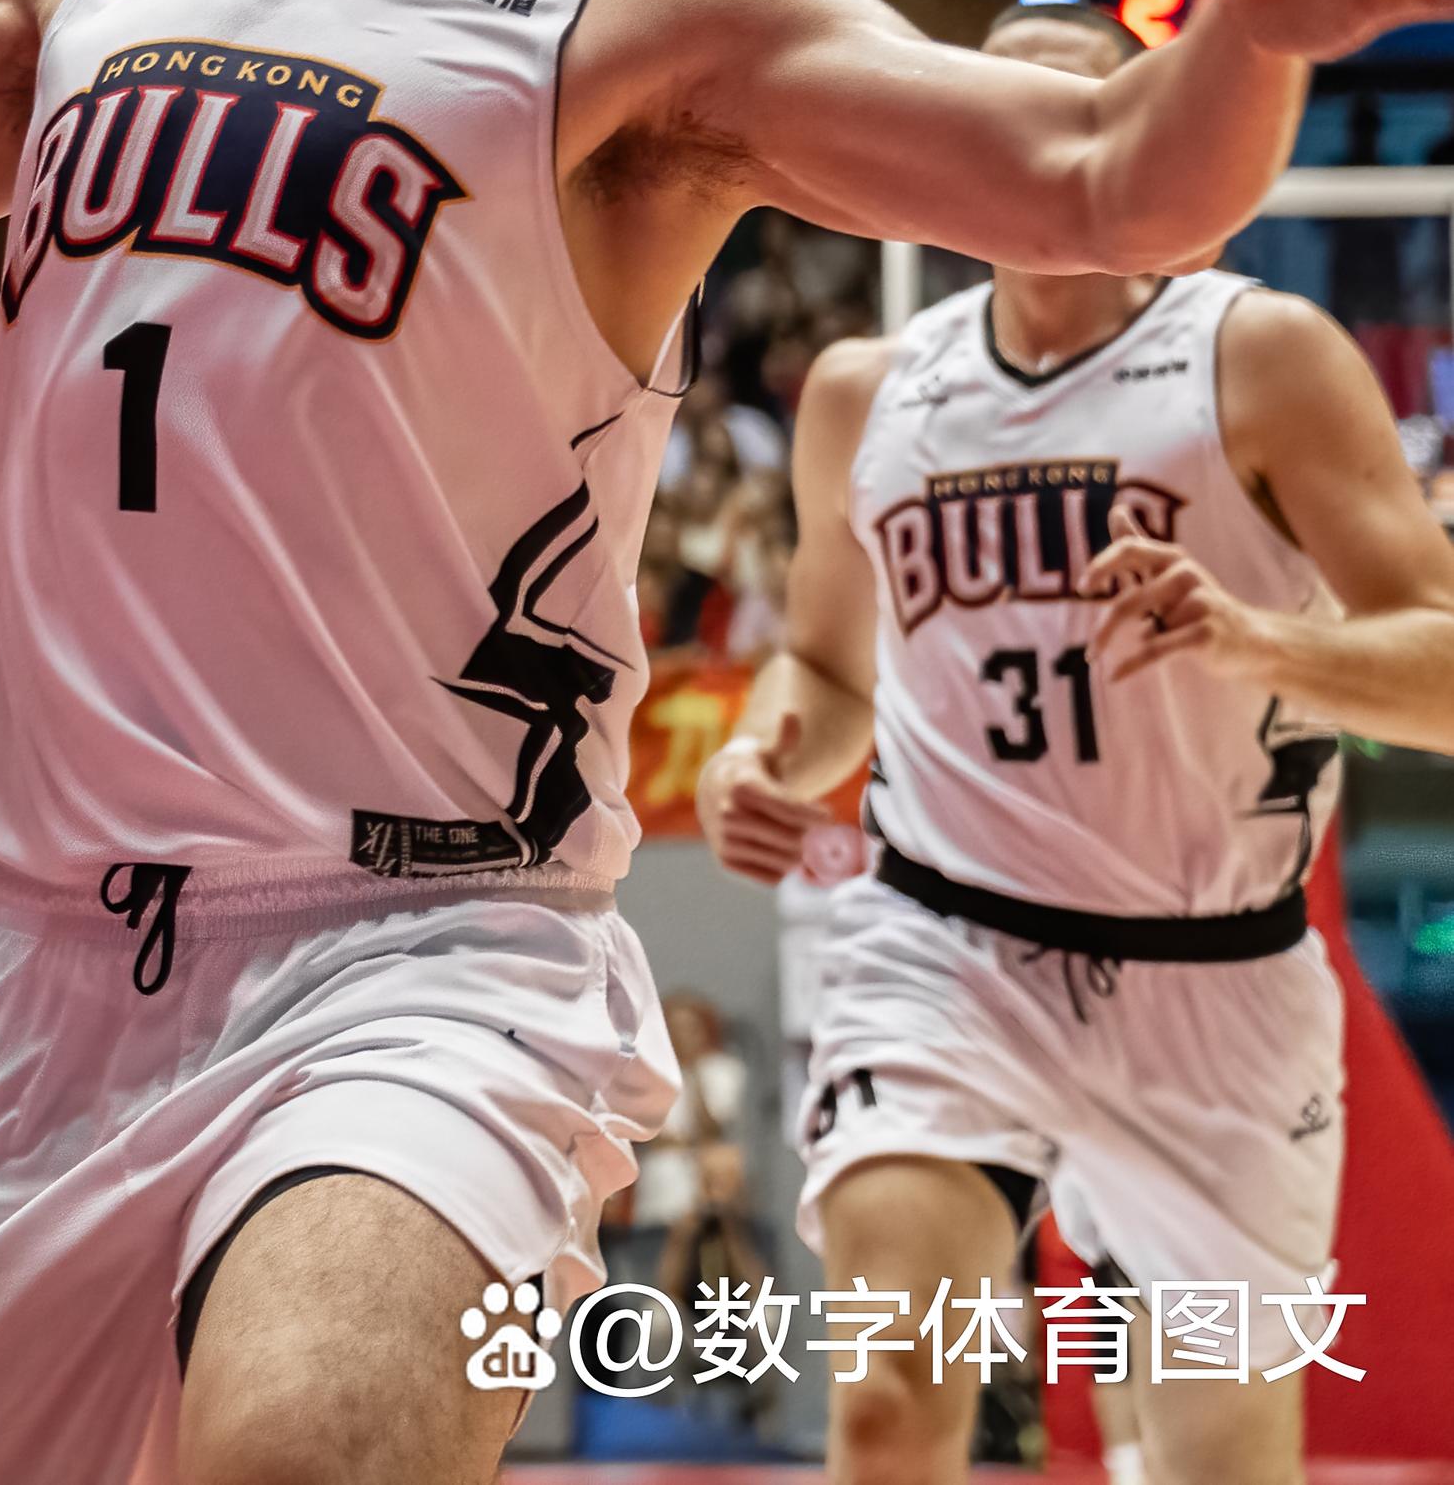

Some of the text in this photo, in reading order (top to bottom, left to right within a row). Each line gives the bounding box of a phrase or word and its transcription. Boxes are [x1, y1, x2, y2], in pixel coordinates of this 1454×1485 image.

[101, 49, 364, 109] HONG KONG
[3, 86, 444, 329] BULLS
[103, 322, 172, 511] 1
[983, 646, 1100, 765] 31
[414, 825, 480, 844] THE ONE
